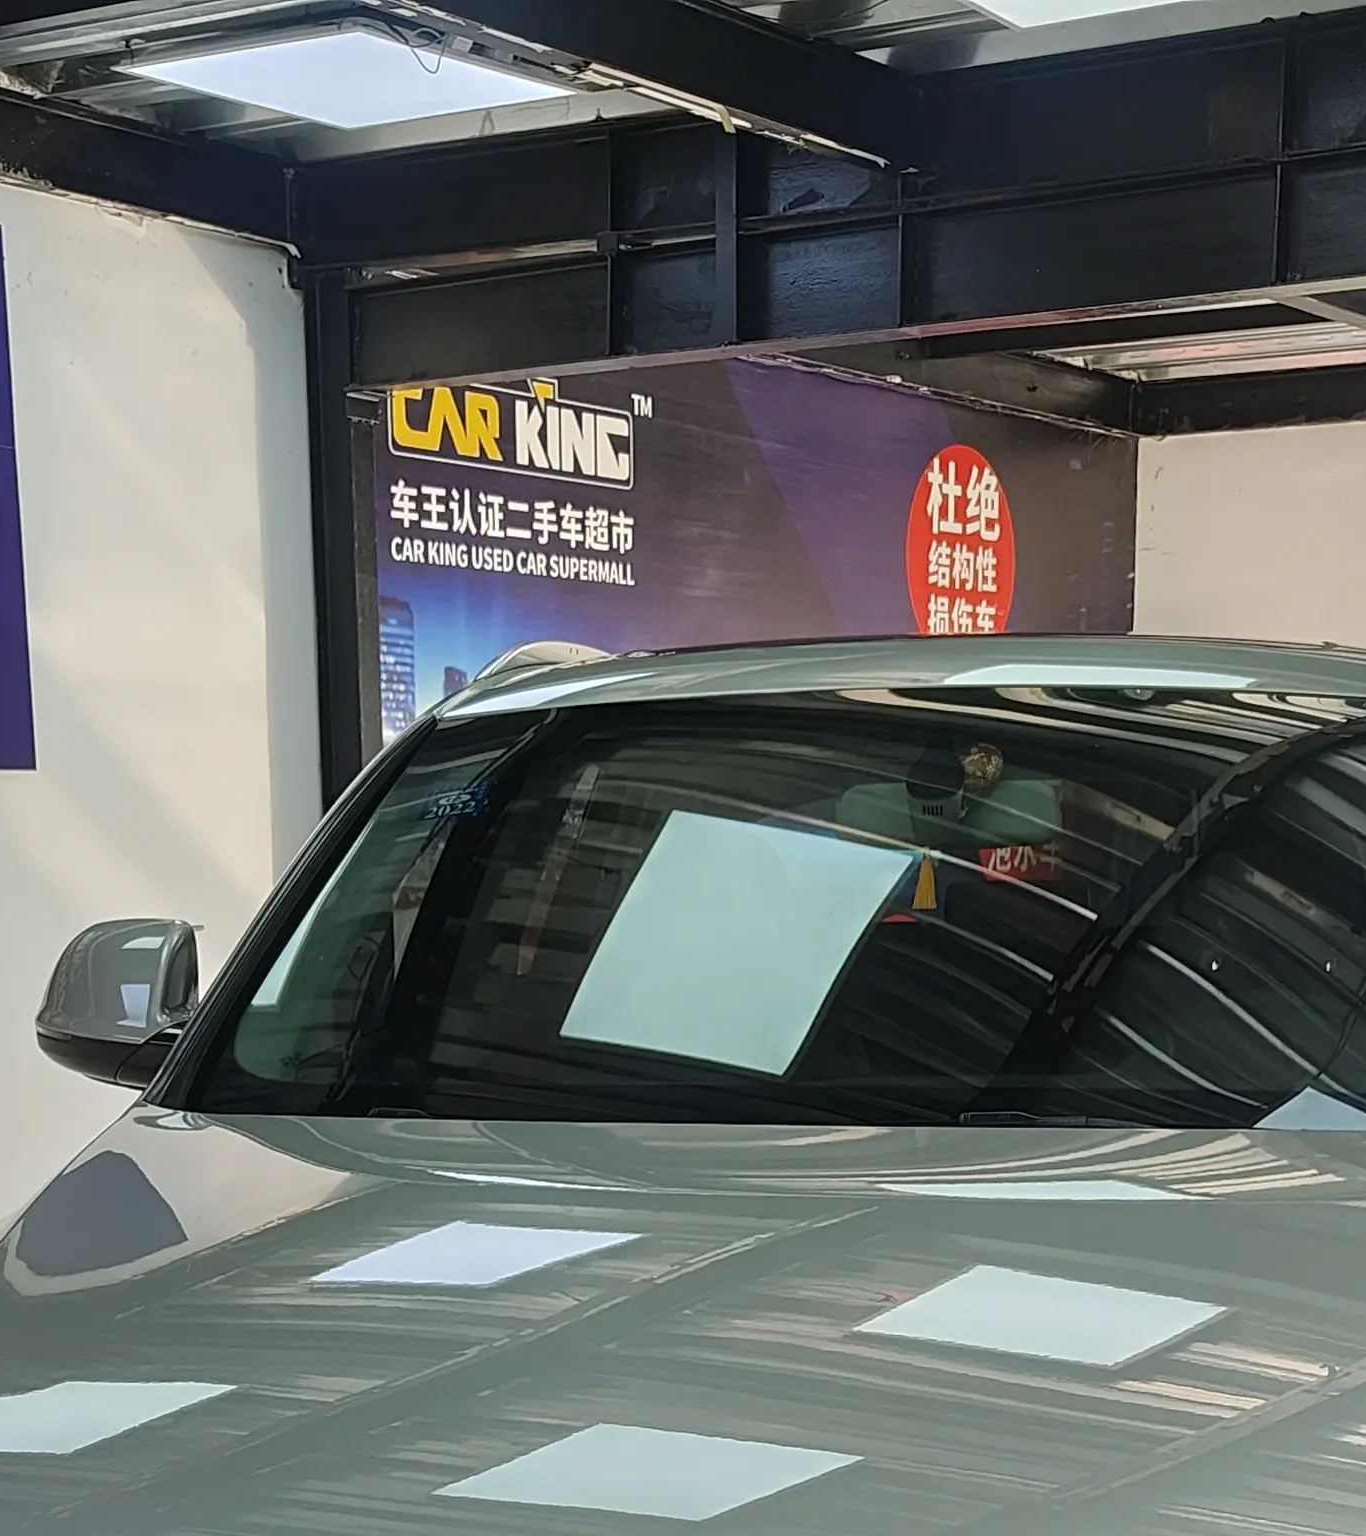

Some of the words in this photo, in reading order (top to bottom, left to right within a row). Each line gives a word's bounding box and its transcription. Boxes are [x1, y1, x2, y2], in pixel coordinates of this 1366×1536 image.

[391, 385, 504, 462] CAR
[514, 381, 631, 480] KING
[390, 477, 636, 555] 车王认证二手车超市
[926, 456, 1001, 542] 杜绝
[391, 535, 426, 564] CAR
[428, 541, 469, 569] KING
[471, 546, 515, 573] USED
[516, 550, 548, 577] CAR
[549, 555, 636, 586] SUPERMALL
[927, 539, 998, 593] 结构性
[927, 593, 997, 636] 损伤车
[423, 801, 477, 820] 2022
